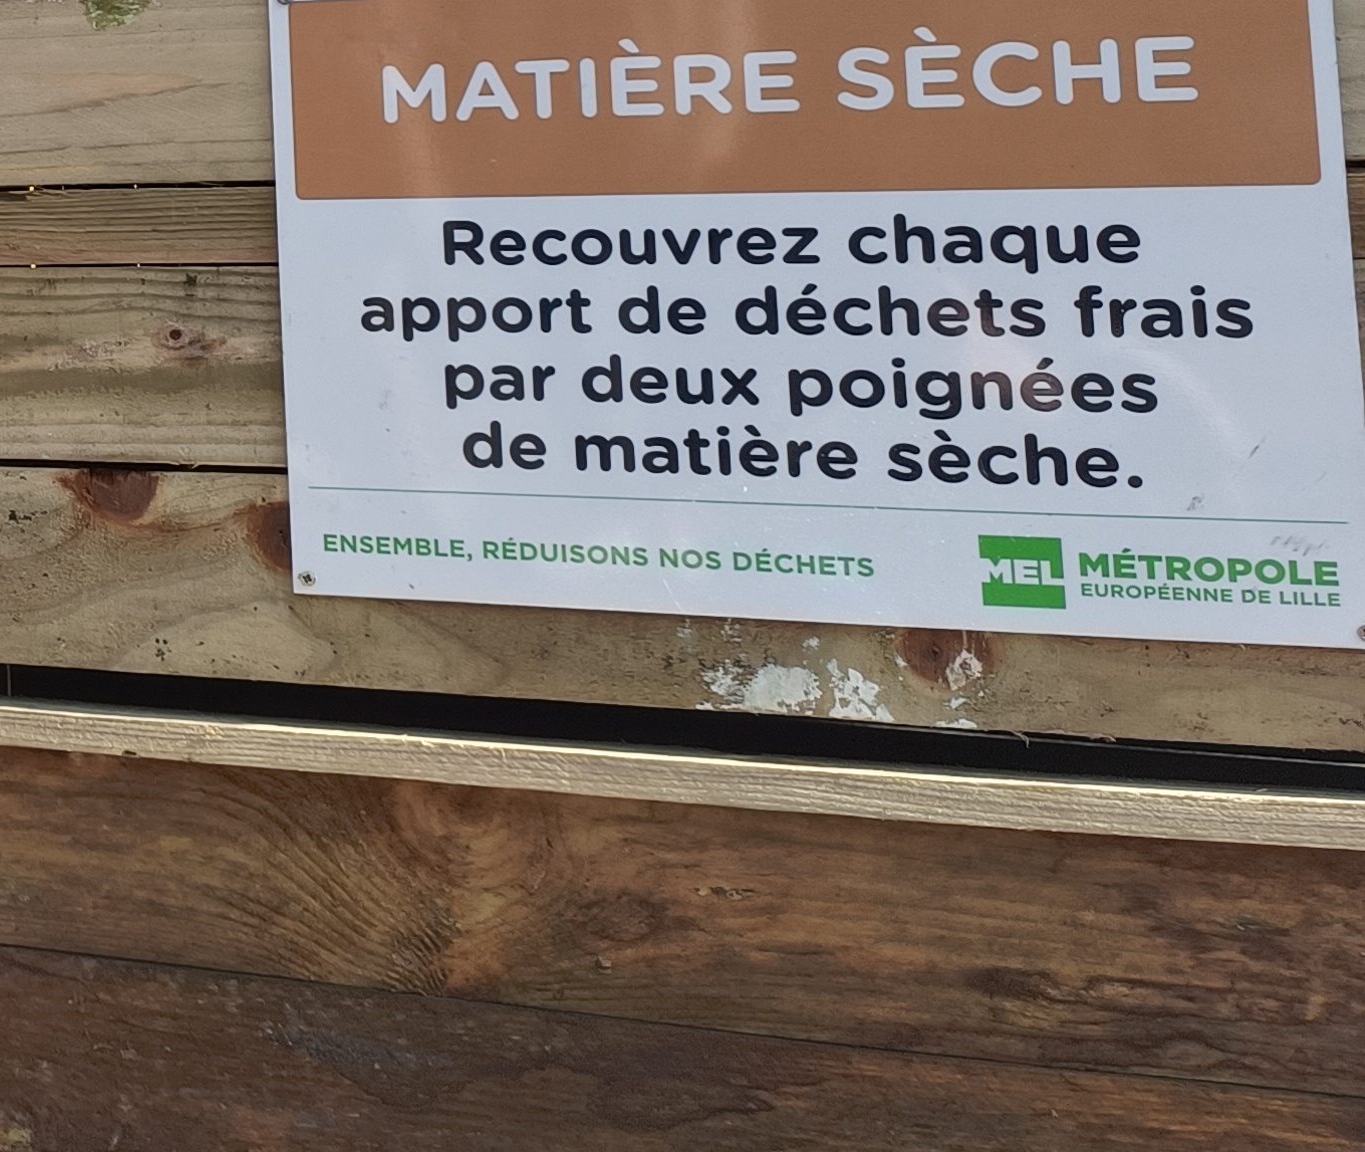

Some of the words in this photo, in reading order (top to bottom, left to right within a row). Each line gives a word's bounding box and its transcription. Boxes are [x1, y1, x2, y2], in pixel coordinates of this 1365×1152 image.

[382, 38, 800, 123] MATIÈRE
[837, 26, 1198, 110] SÈCHE
[442, 220, 820, 265] Recouvrez
[848, 213, 1140, 274] chaque
[360, 288, 592, 342] apport
[618, 284, 706, 335] de
[735, 283, 1045, 337] déchets
[1073, 284, 1253, 338] frais
[444, 364, 555, 409] par
[581, 353, 759, 405] deux
[788, 357, 1157, 420] poignées
[462, 420, 546, 470] de
[574, 424, 858, 480] matière
[887, 429, 1142, 488] sèche.
[323, 533, 472, 561] ENSEMBLE,
[482, 536, 648, 566] RÉDUISONS
[659, 547, 721, 570] NOS
[732, 547, 874, 577] DÉCHETS
[1078, 547, 1339, 586] MÉTROPOLE
[1080, 582, 1233, 603] EUROPÉENNE
[1241, 589, 1271, 604] DE
[1279, 590, 1340, 607] LILLE
